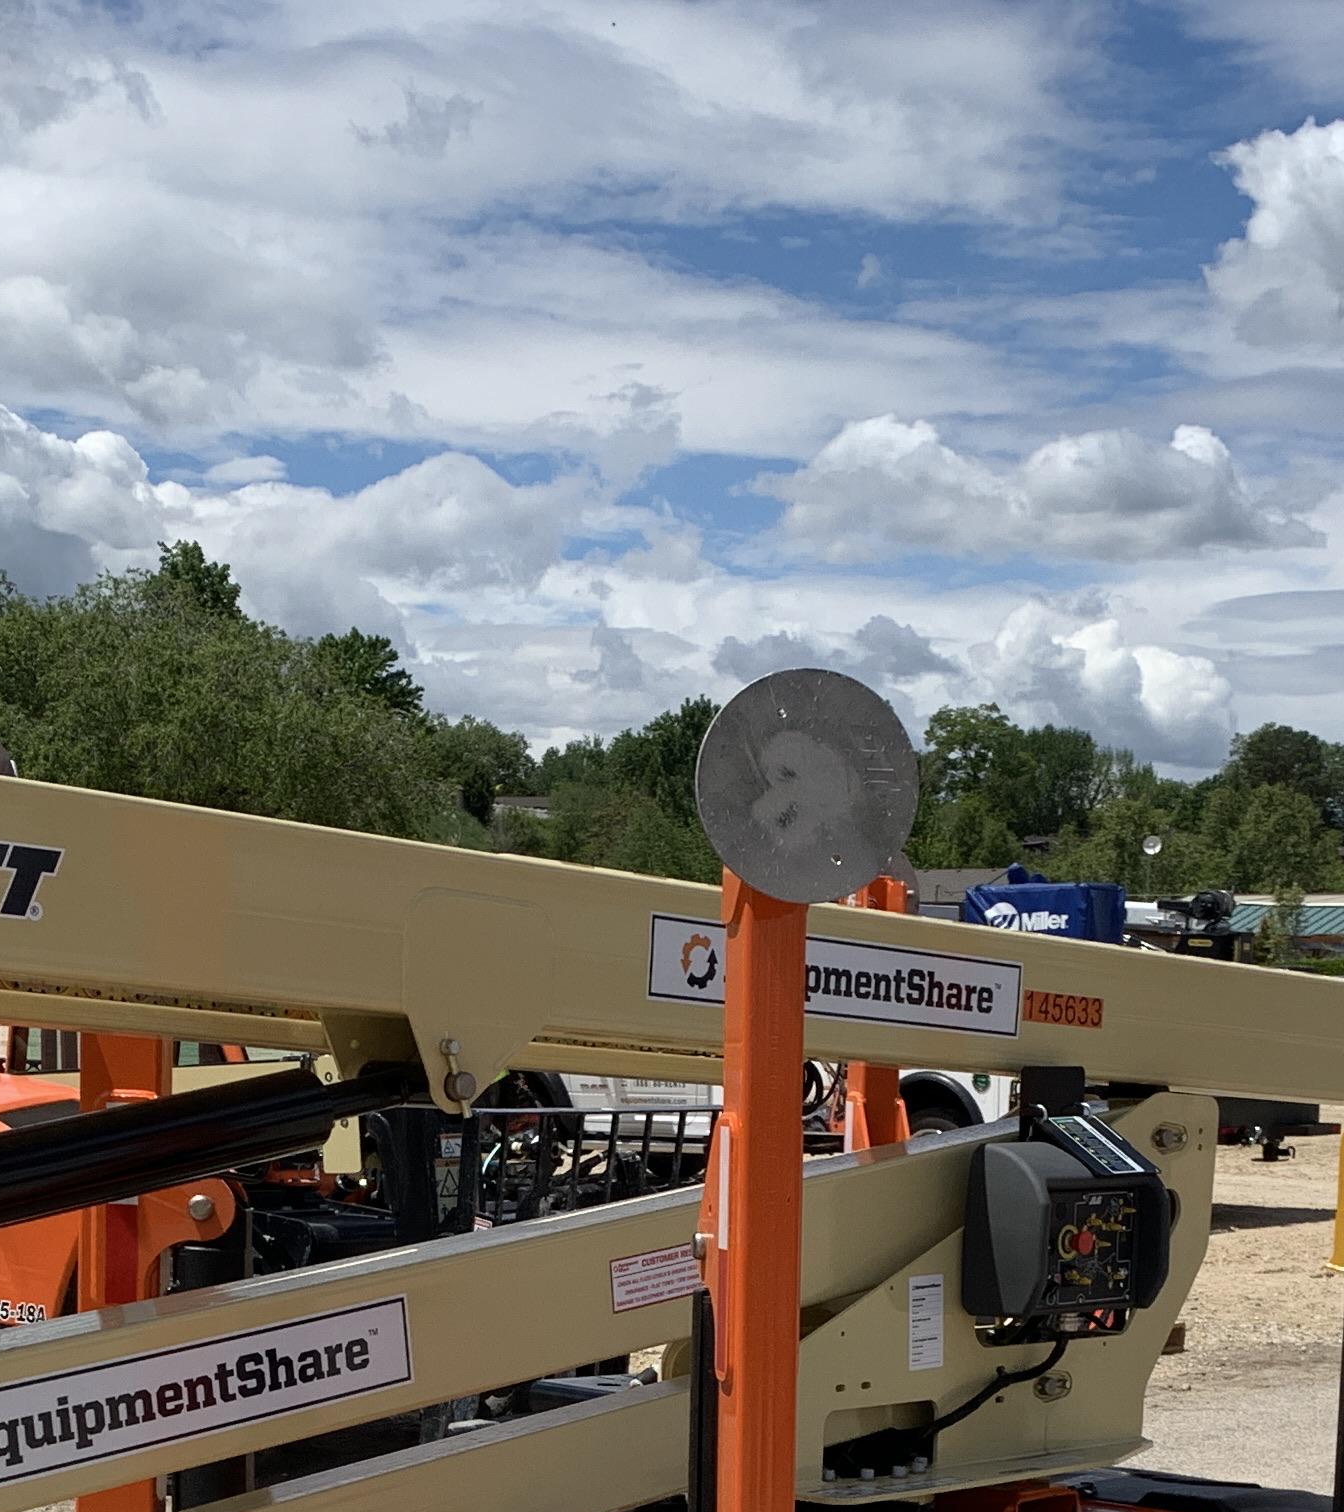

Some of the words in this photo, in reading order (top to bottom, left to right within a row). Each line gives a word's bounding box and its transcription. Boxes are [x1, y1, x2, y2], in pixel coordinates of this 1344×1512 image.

[1021, 911, 1069, 932] Miller
[805, 963, 994, 1014] pmentShare
[1026, 991, 1102, 1028] 145633
[642, 1251, 679, 1267] CUSTOMER
